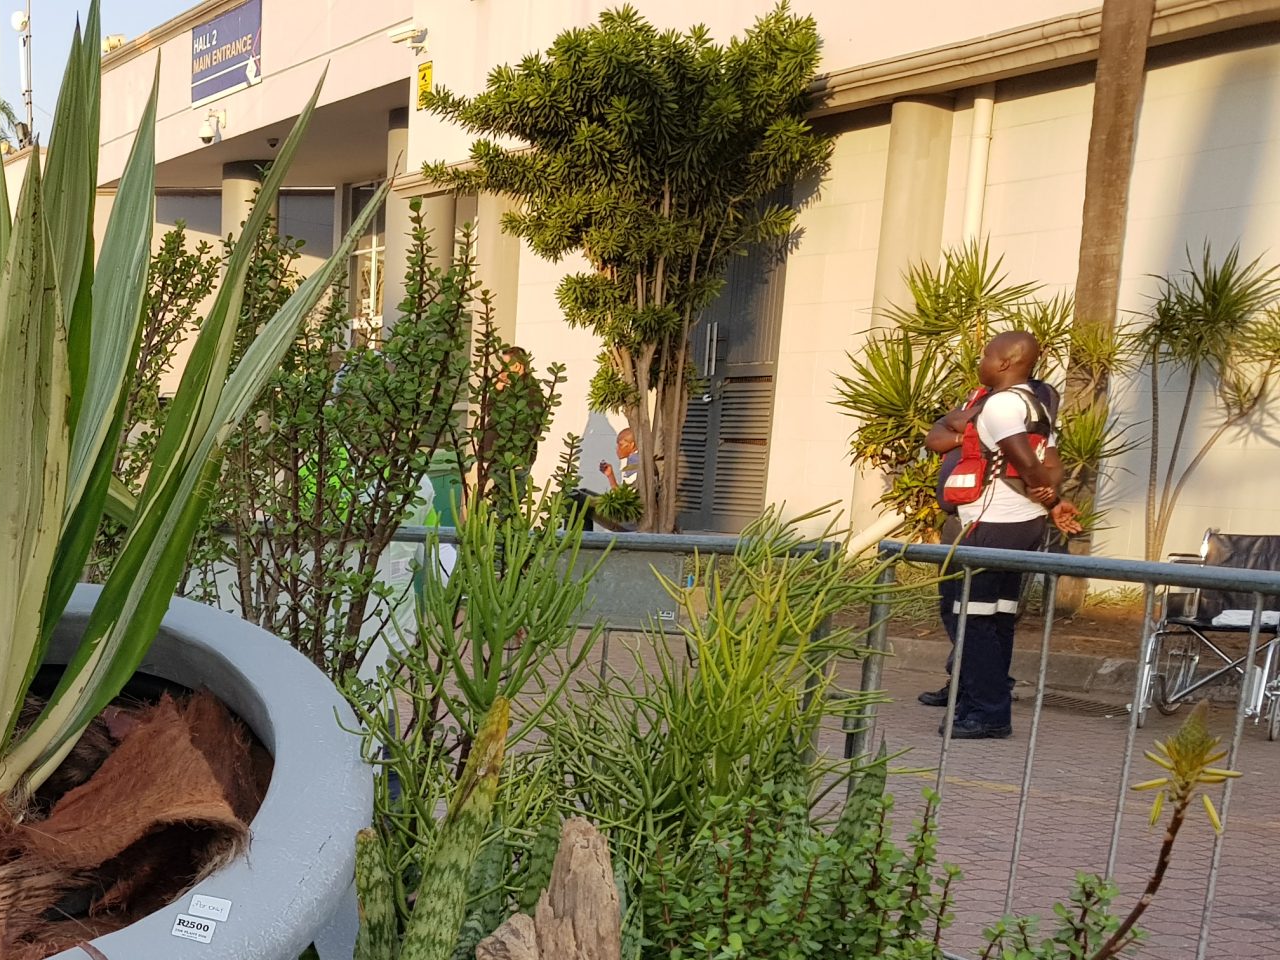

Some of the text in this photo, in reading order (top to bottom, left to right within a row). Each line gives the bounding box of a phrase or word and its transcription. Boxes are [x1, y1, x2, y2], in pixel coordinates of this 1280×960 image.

[193, 29, 218, 54] HALL 2
[193, 34, 252, 74] MAIN ENTRANCE
